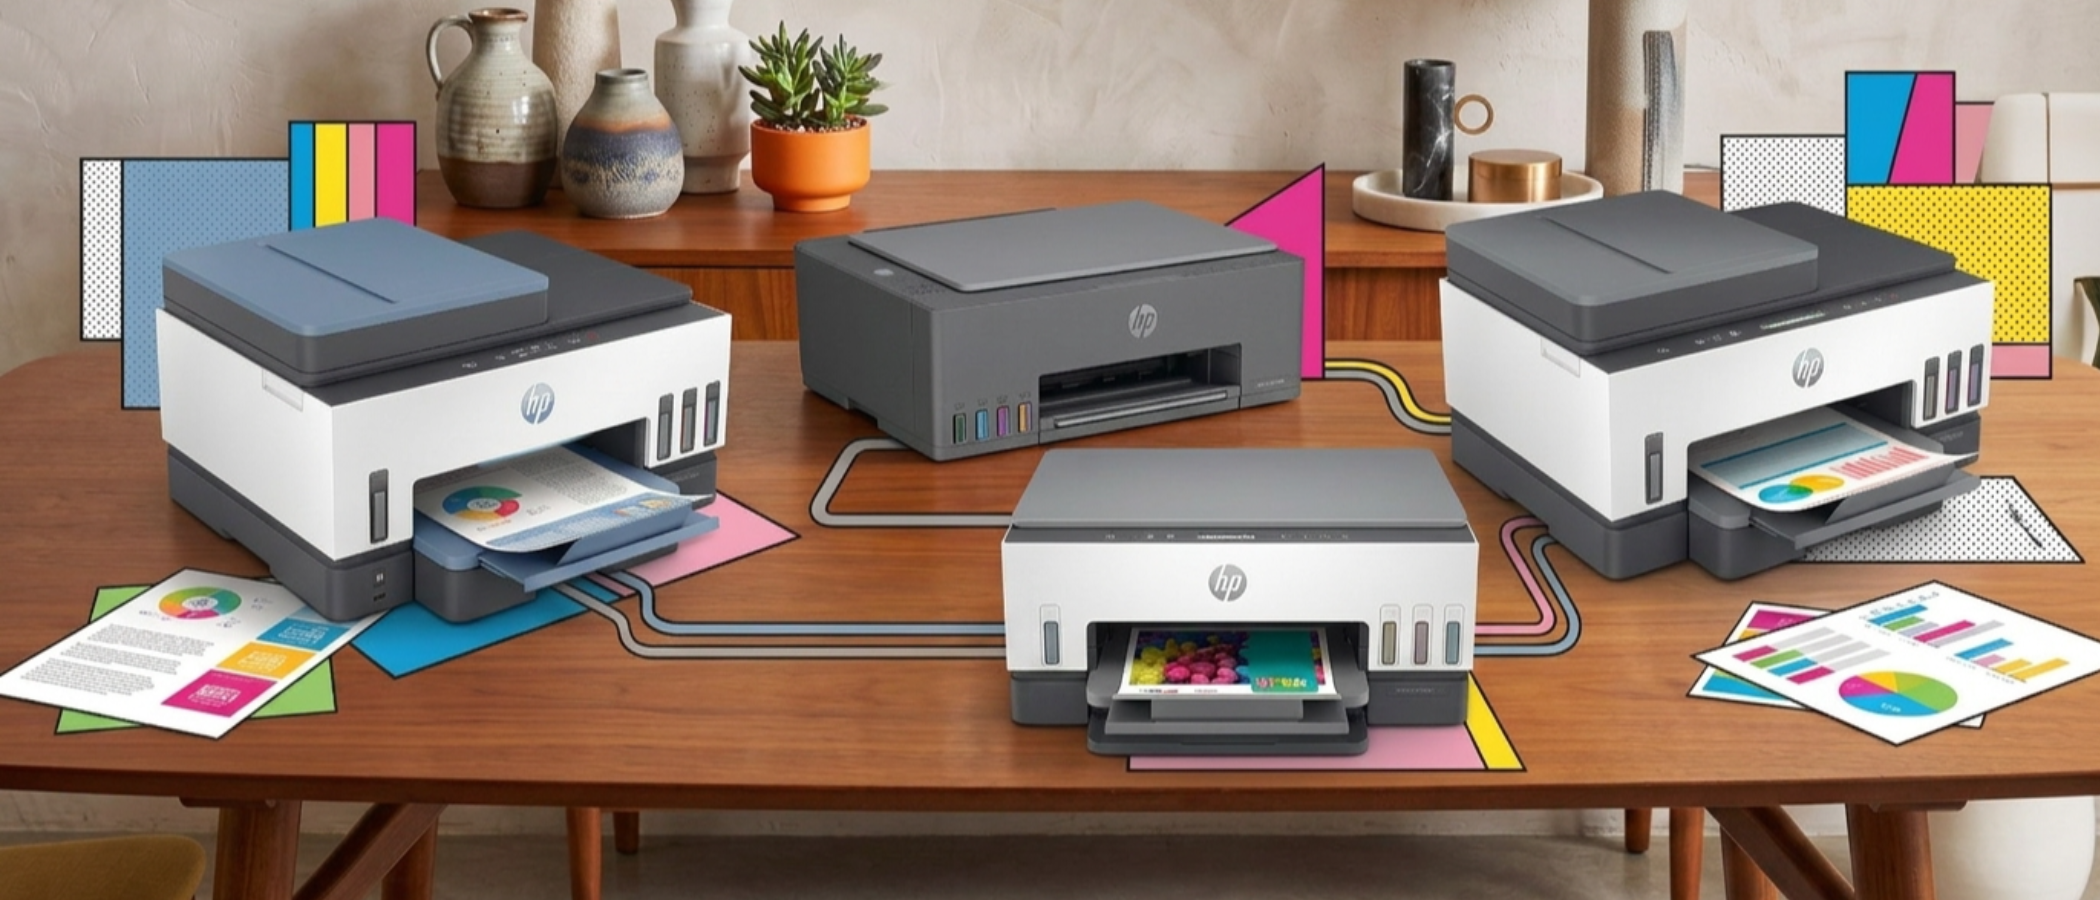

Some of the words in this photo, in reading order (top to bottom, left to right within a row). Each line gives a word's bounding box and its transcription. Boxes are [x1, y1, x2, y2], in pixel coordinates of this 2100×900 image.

[1130, 304, 1157, 339] hp
[1795, 348, 1822, 388] hp
[525, 383, 553, 424] hp
[1212, 564, 1244, 602] hp
